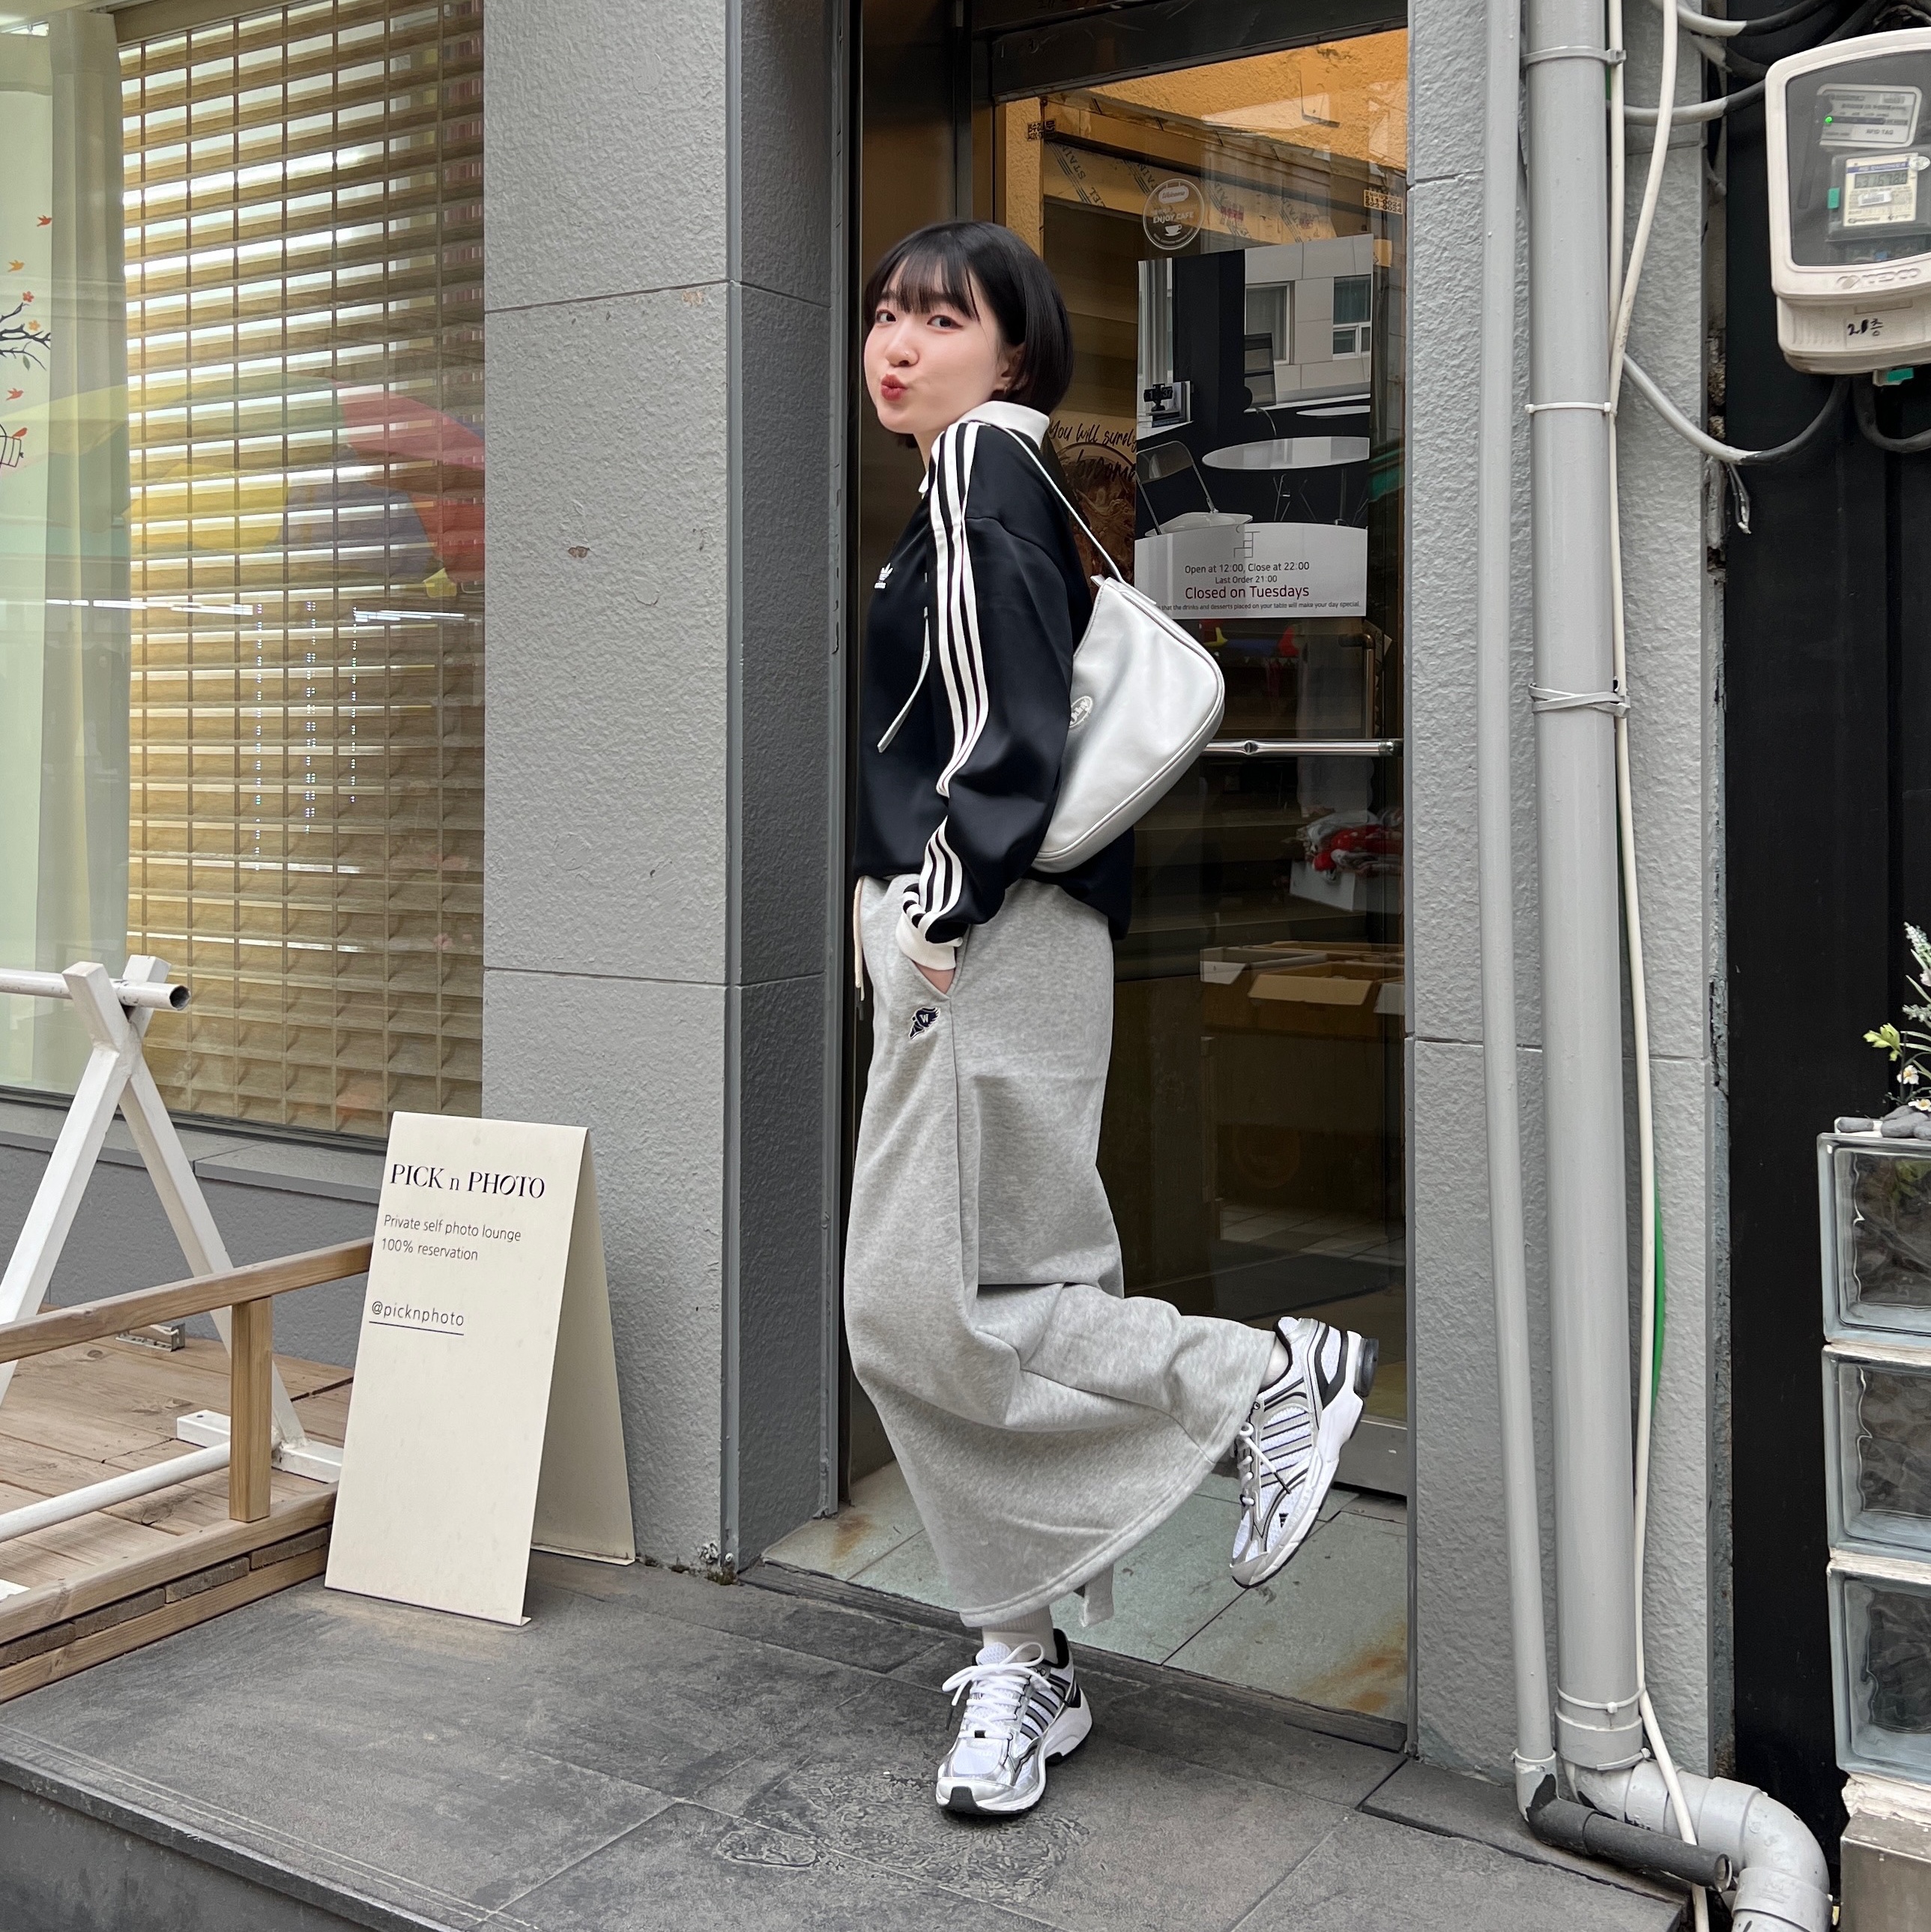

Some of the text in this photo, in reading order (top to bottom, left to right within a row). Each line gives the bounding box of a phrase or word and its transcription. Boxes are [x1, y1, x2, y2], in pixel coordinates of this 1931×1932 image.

[1153, 214, 1176, 224] ENJOY
[1176, 211, 1194, 221] CAFE
[1185, 561, 1310, 576] Open at 12:00, Close at 22:00
[1215, 575, 1278, 585] Last Order 21:00
[1185, 584, 1310, 600] Closed on Tuesdays
[1211, 602, 1233, 610] desserts
[1234, 601, 1251, 610] placed
[390, 1163, 546, 1199] PICK n PHOTO
[384, 1214, 522, 1243] Private self photo lounge
[381, 1237, 479, 1261] 100% reservation
[372, 1300, 465, 1326] @picknphoto
